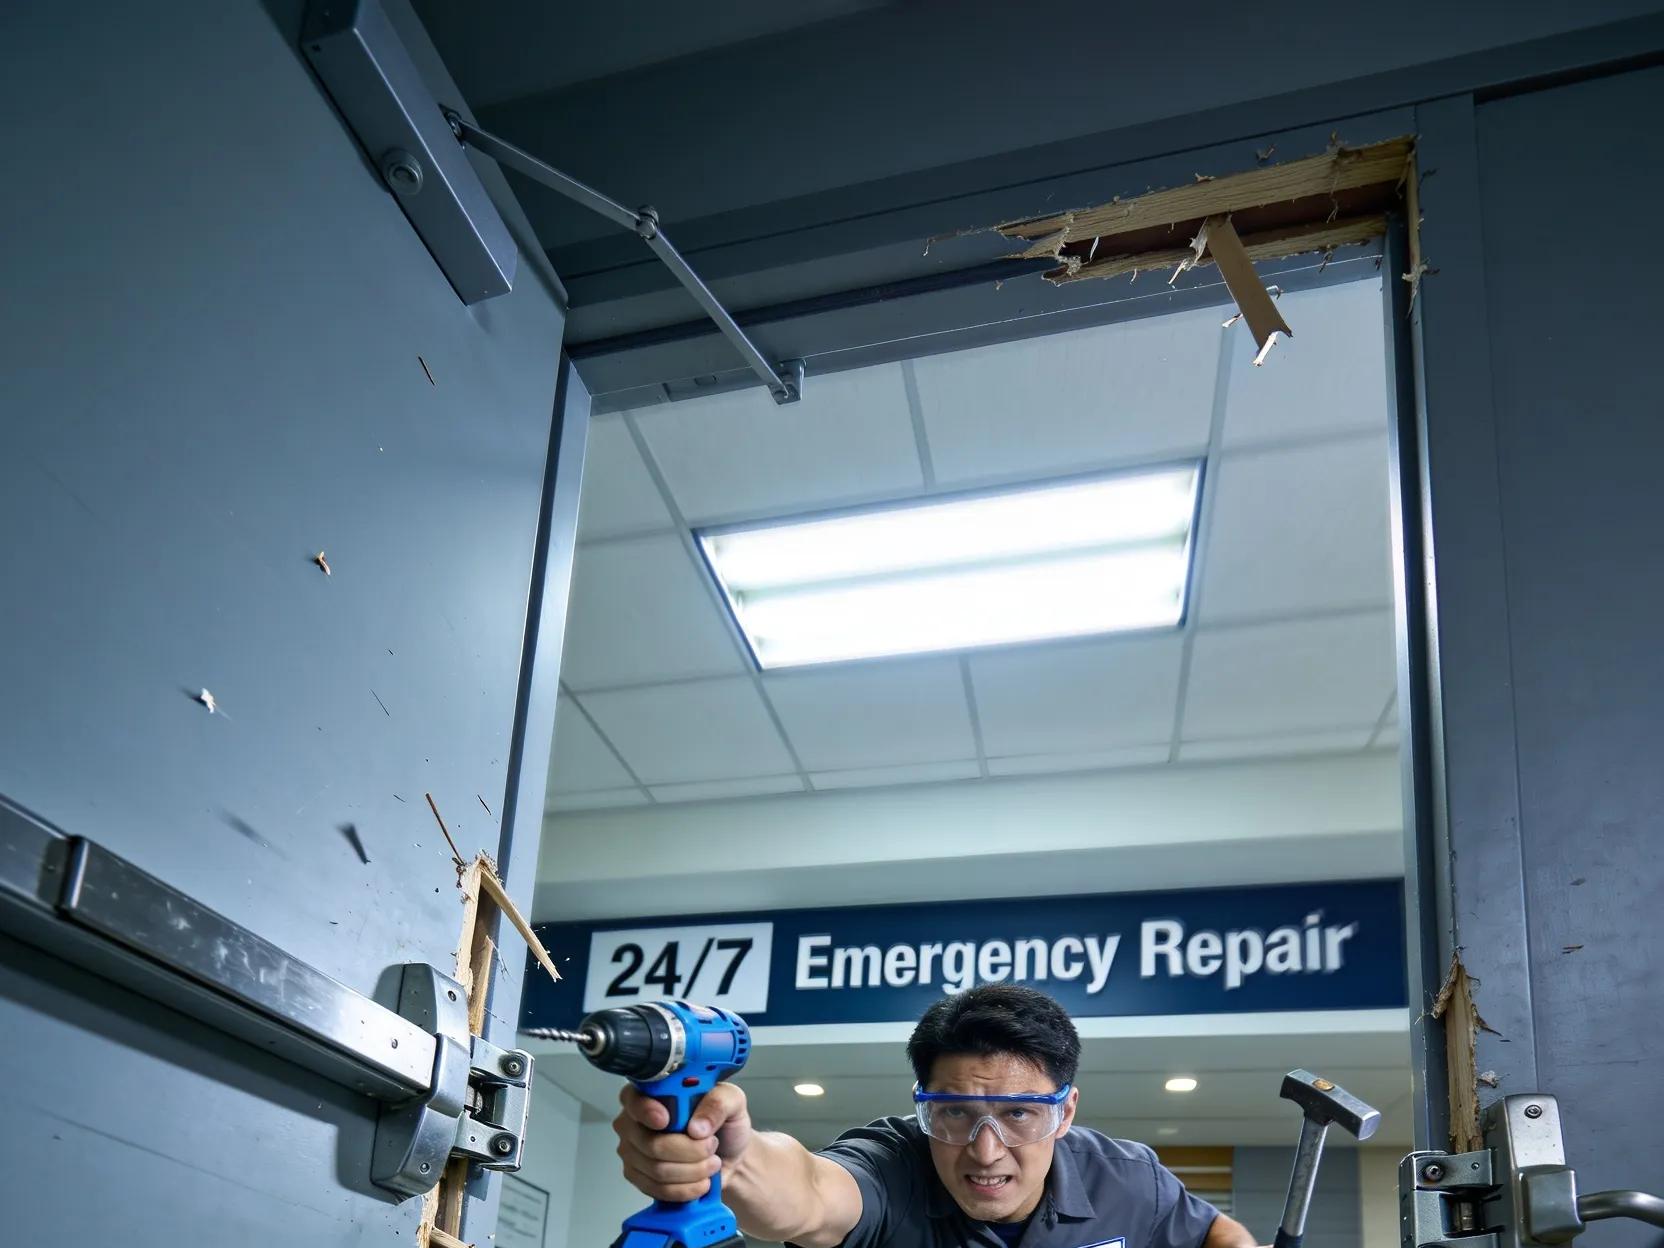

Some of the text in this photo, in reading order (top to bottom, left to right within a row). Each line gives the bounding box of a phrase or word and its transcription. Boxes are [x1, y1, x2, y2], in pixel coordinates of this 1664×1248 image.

[606, 909, 1357, 999] 24/7 Emergency Repair
